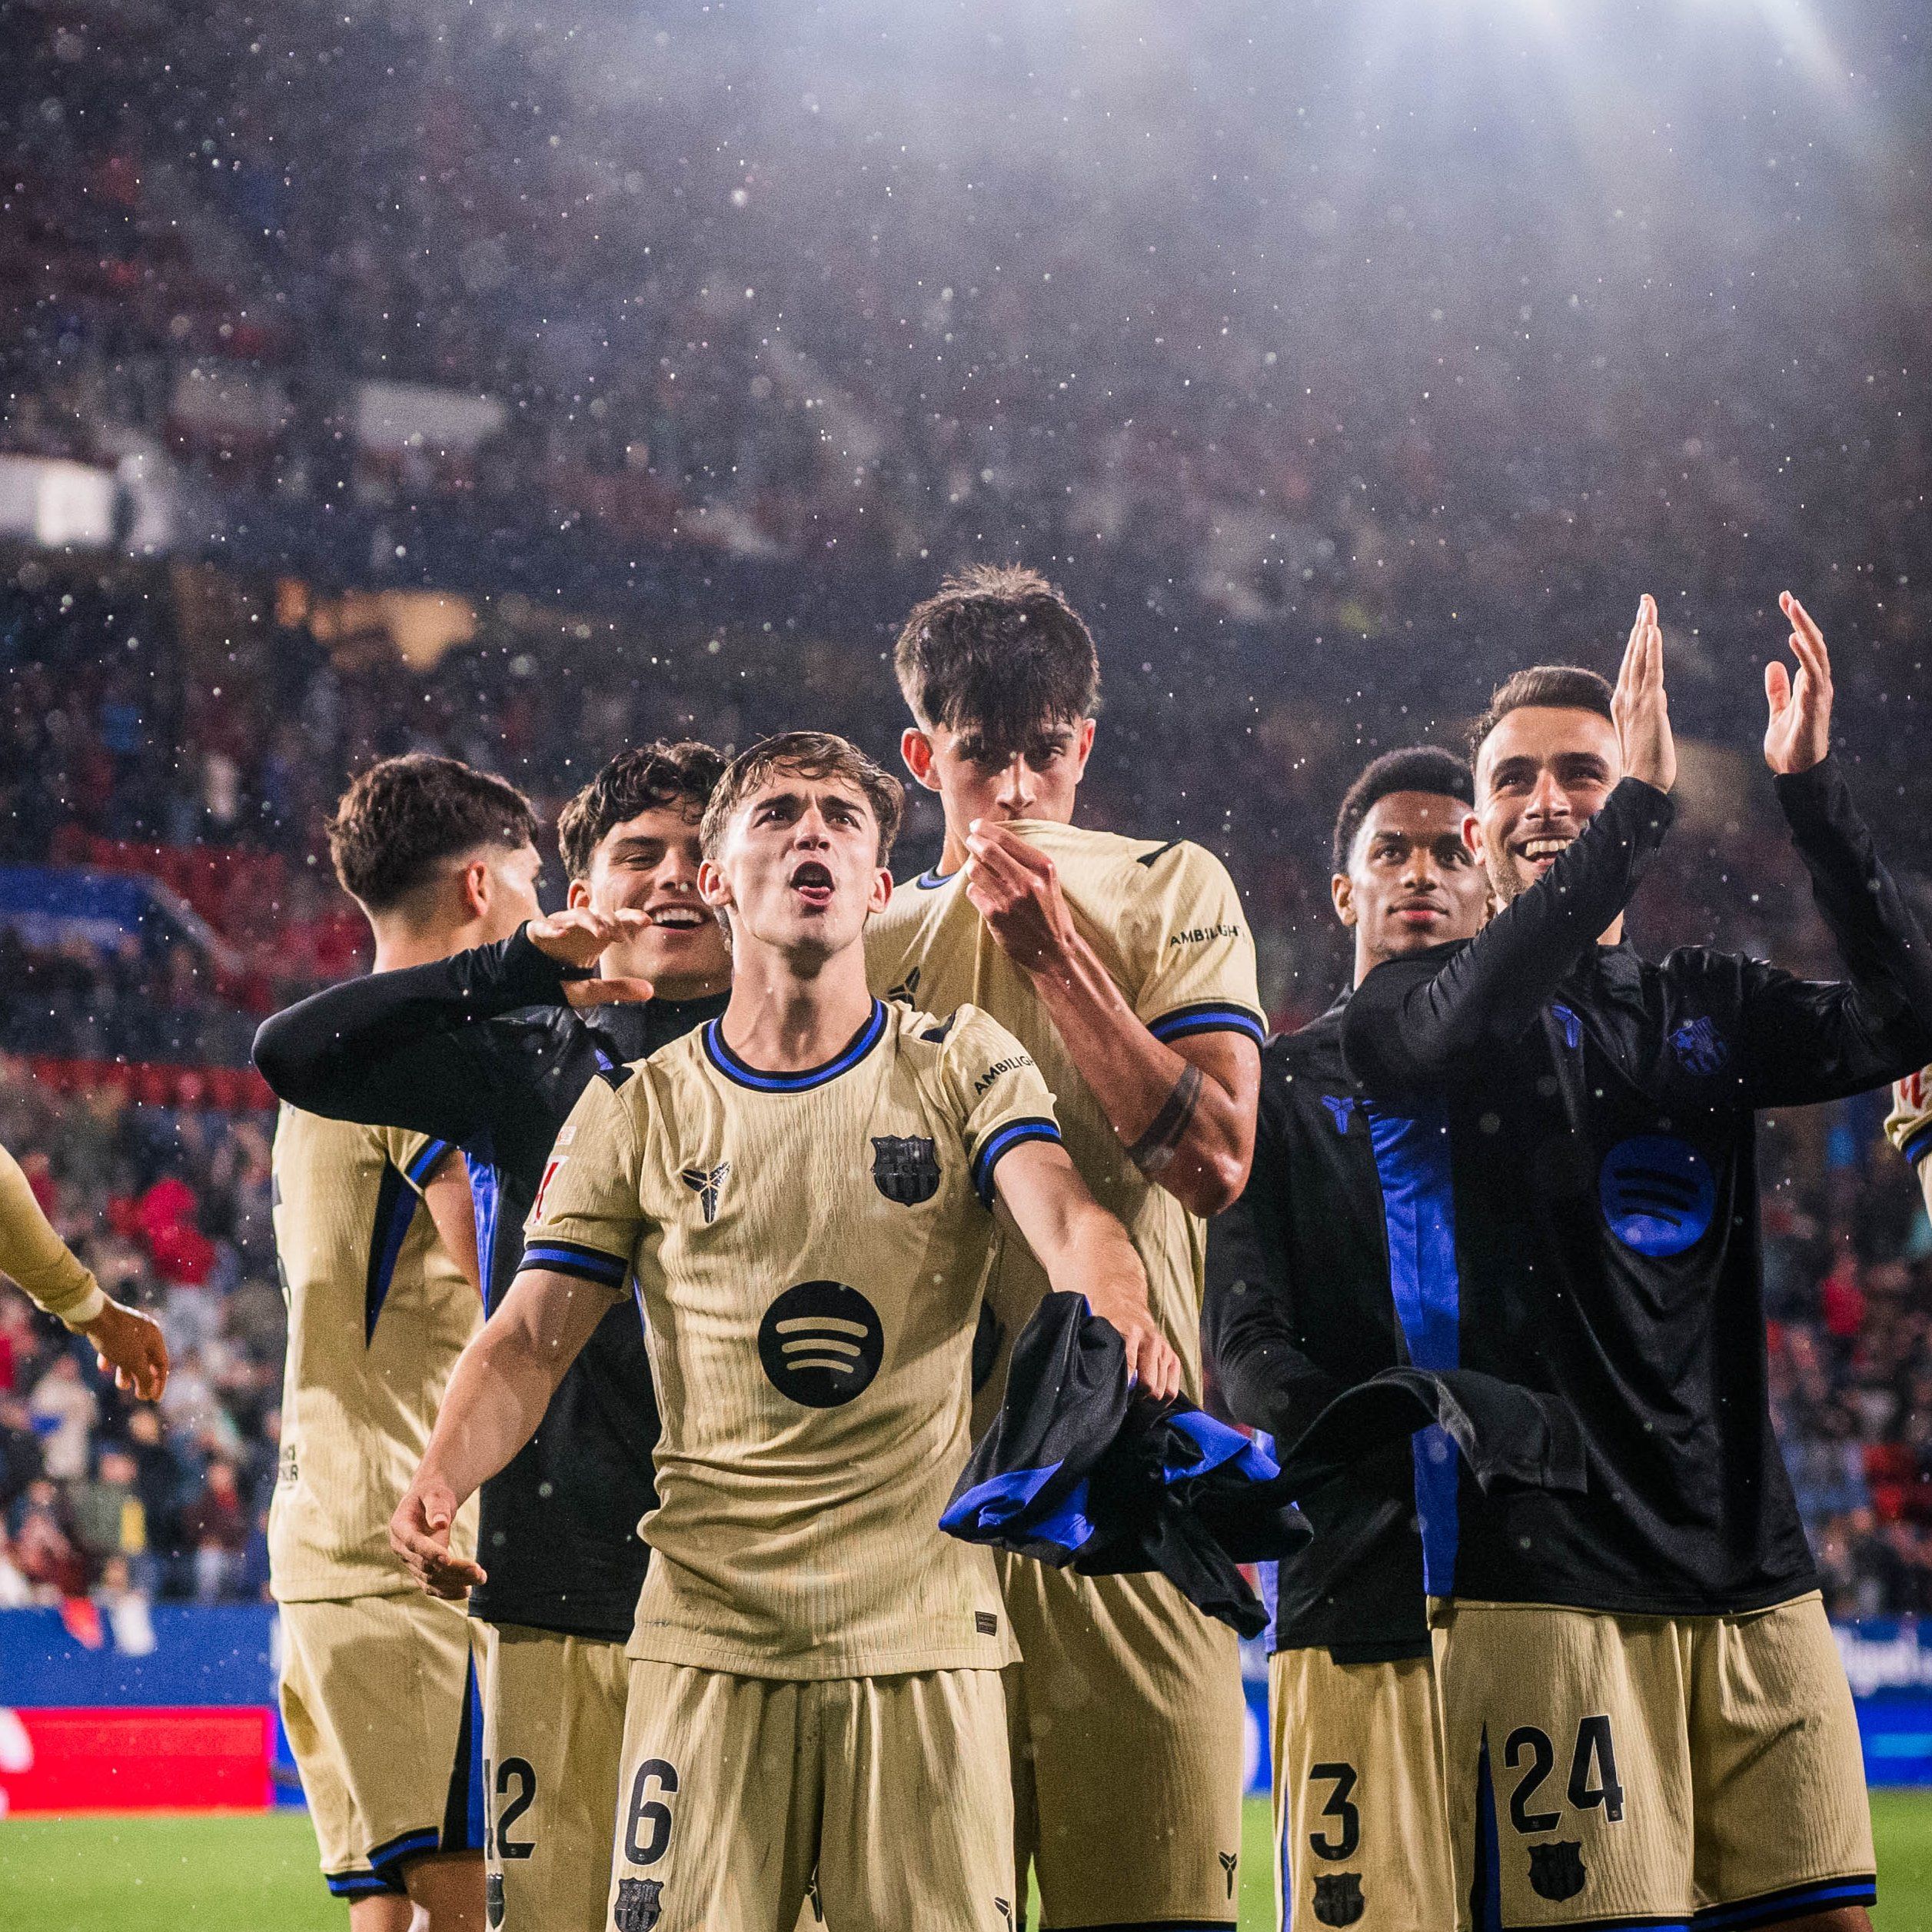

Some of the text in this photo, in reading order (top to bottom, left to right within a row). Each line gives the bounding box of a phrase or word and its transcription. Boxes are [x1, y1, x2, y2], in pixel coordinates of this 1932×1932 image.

[625, 1758, 678, 1866] 6
[1309, 1762, 1359, 1861] 3
[1505, 1715, 1624, 1834] 24
